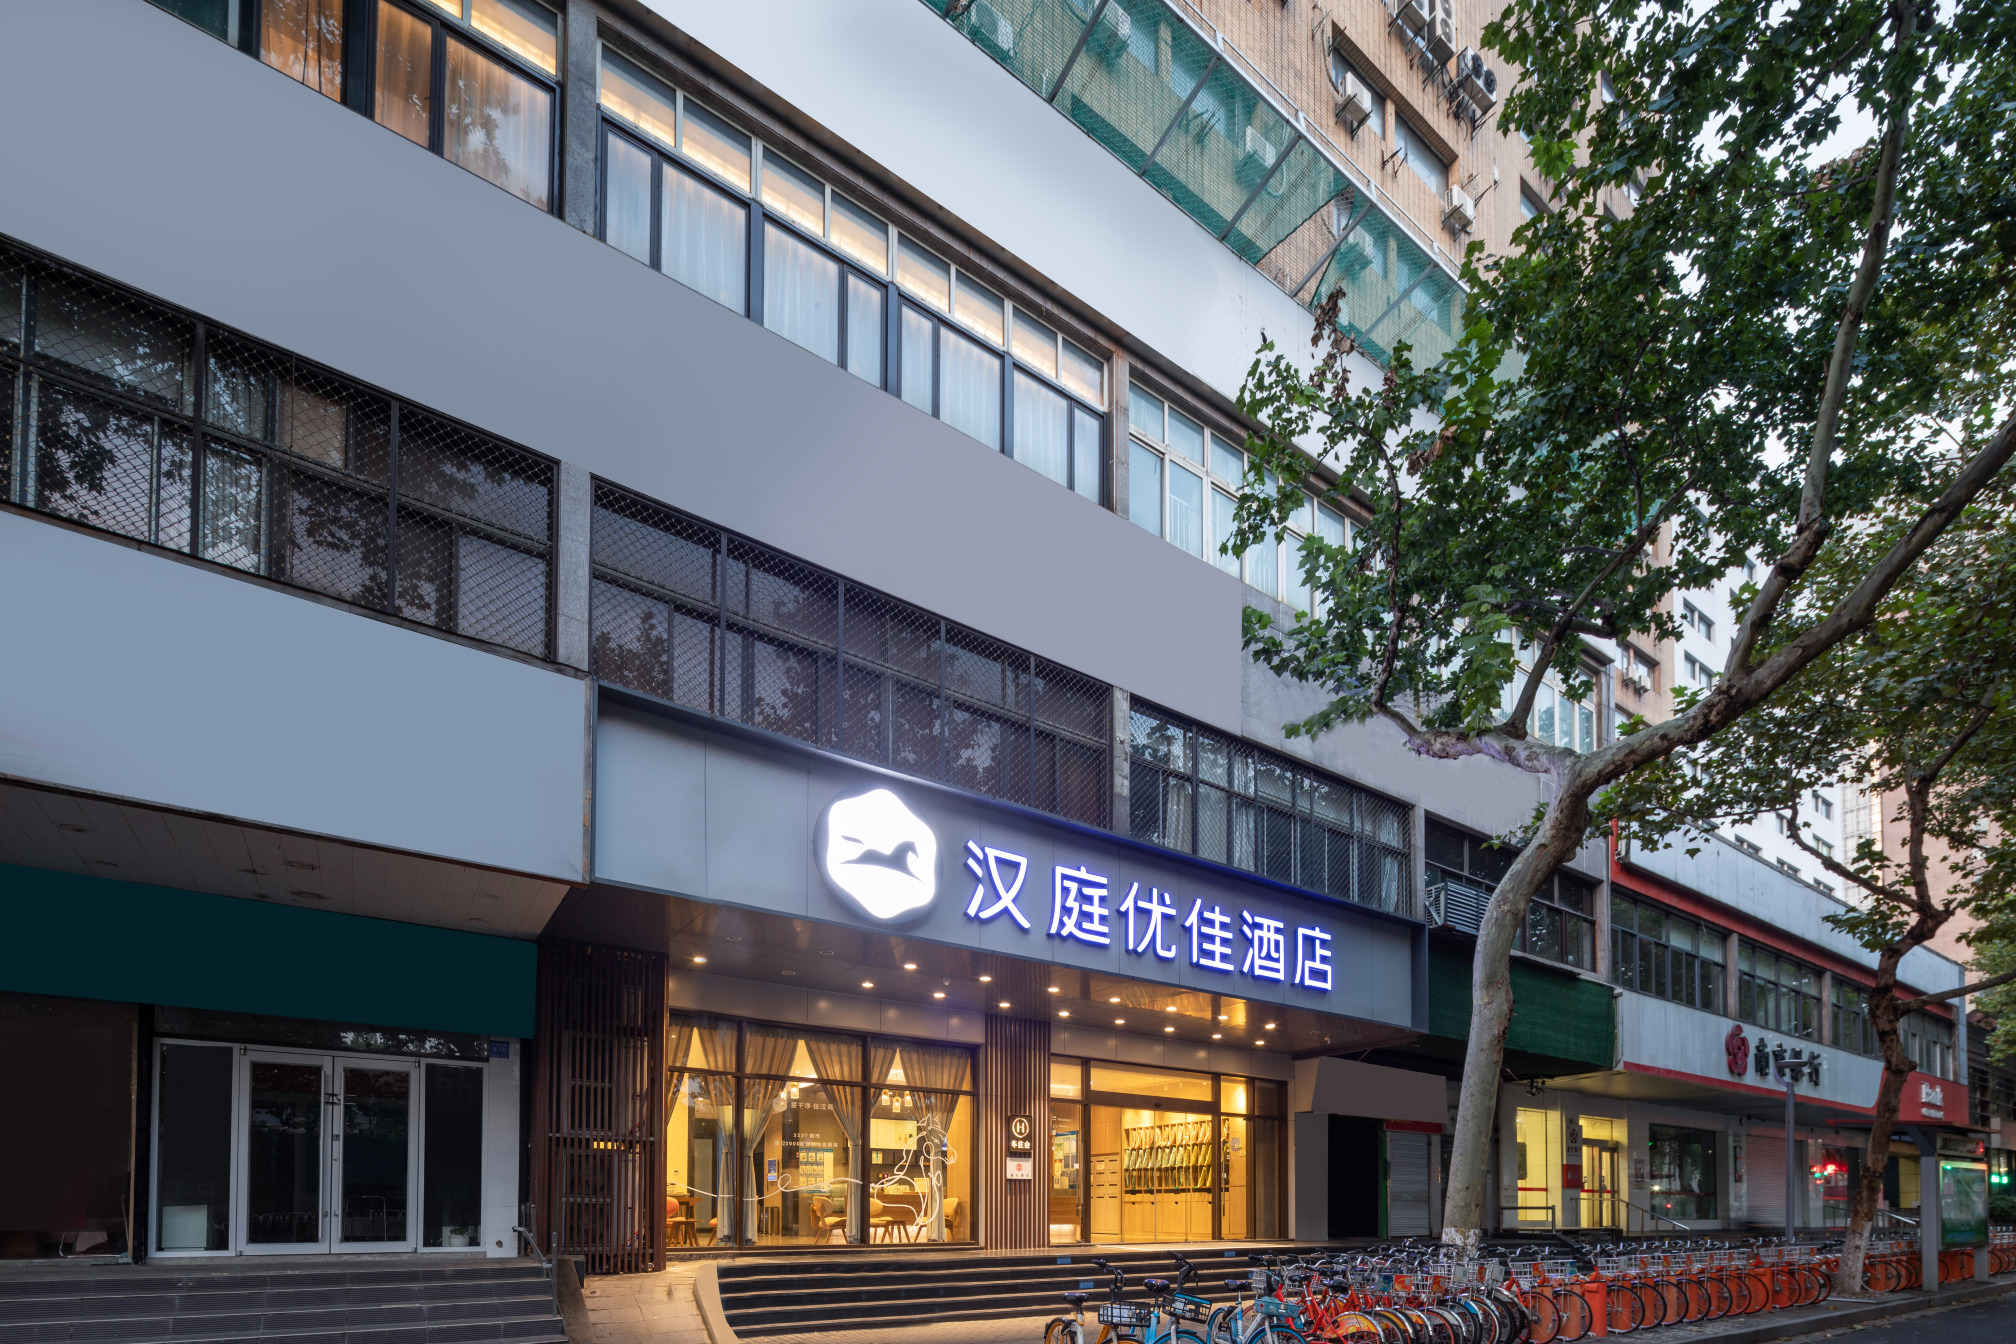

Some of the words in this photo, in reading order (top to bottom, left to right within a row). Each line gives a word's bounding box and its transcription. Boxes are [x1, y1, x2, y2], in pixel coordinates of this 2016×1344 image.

[964, 839, 1333, 991] 汉庭优佳酒店
